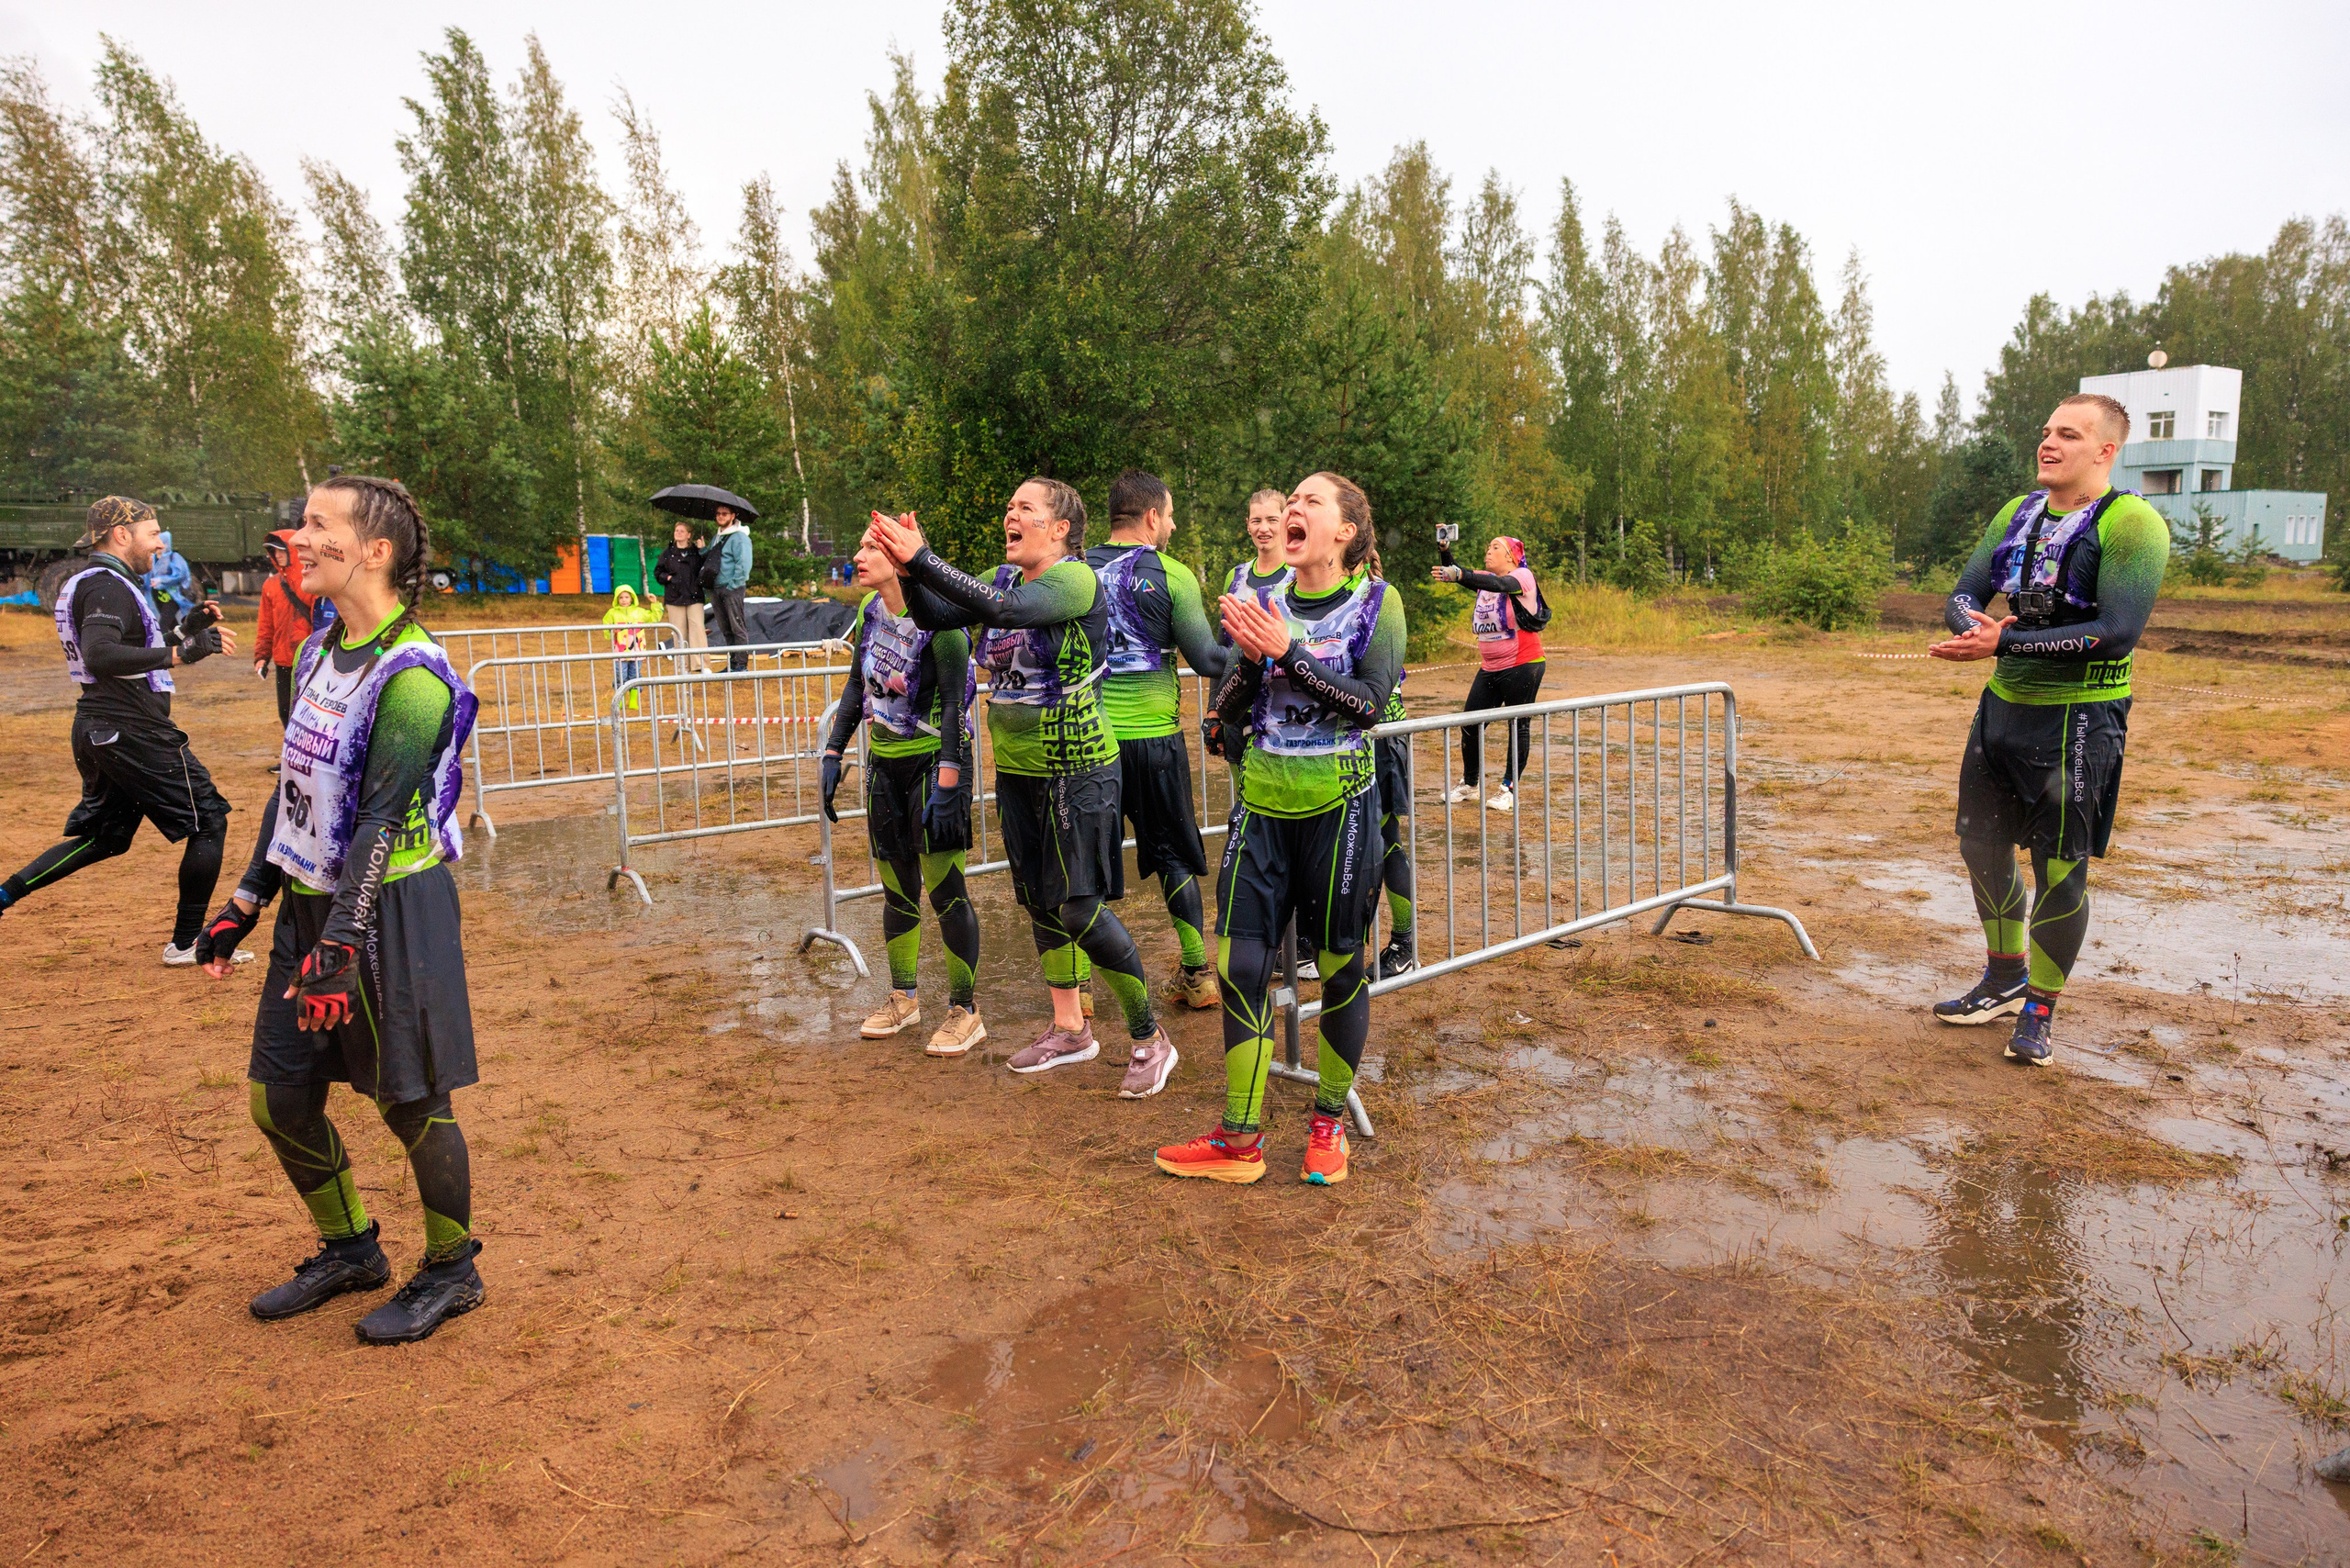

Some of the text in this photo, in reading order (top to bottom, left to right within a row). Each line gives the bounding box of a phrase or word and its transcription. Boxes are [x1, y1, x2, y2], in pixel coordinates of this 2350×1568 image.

[319, 551, 345, 563] ГЕРОЕВ
[321, 543, 344, 554] ГОНКА
[927, 554, 998, 599] Greenway
[2009, 636, 2084, 653] eenway
[872, 644, 907, 671] МАСОВЫЙ
[1294, 660, 1367, 713] Greenway
[319, 697, 348, 713] ГЕРОЕВ
[1286, 738, 1337, 747] ГАЗПРОМБАНК
[2074, 712, 2088, 802] #ТыМожешьВсё
[1341, 799, 1360, 895] #ТыМожешьВсё
